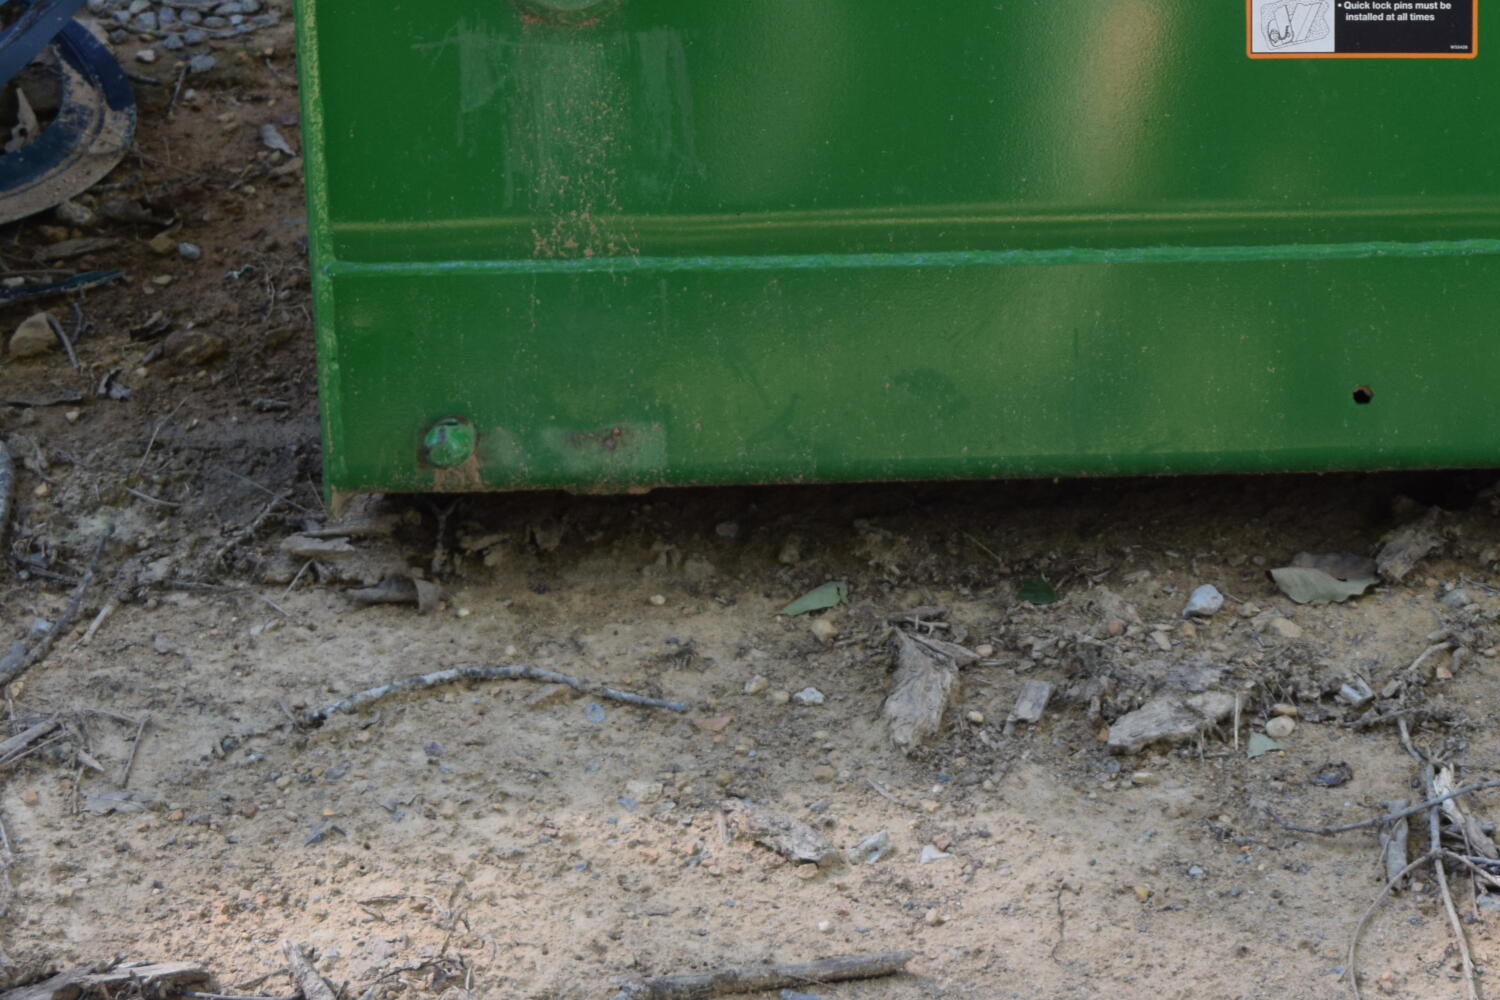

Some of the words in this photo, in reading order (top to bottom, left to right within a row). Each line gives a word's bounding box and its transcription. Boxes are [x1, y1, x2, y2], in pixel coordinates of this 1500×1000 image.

[1344, 1, 1370, 11] Quick
[1372, 1, 1392, 10] lock
[1393, 1, 1413, 13] pins
[1415, 2, 1438, 10] must
[1439, 1, 1452, 10] be
[1345, 12, 1383, 22] installed
[1385, 13, 1396, 22] at
[1397, 12, 1408, 22] all
[1410, 12, 1435, 22] times
